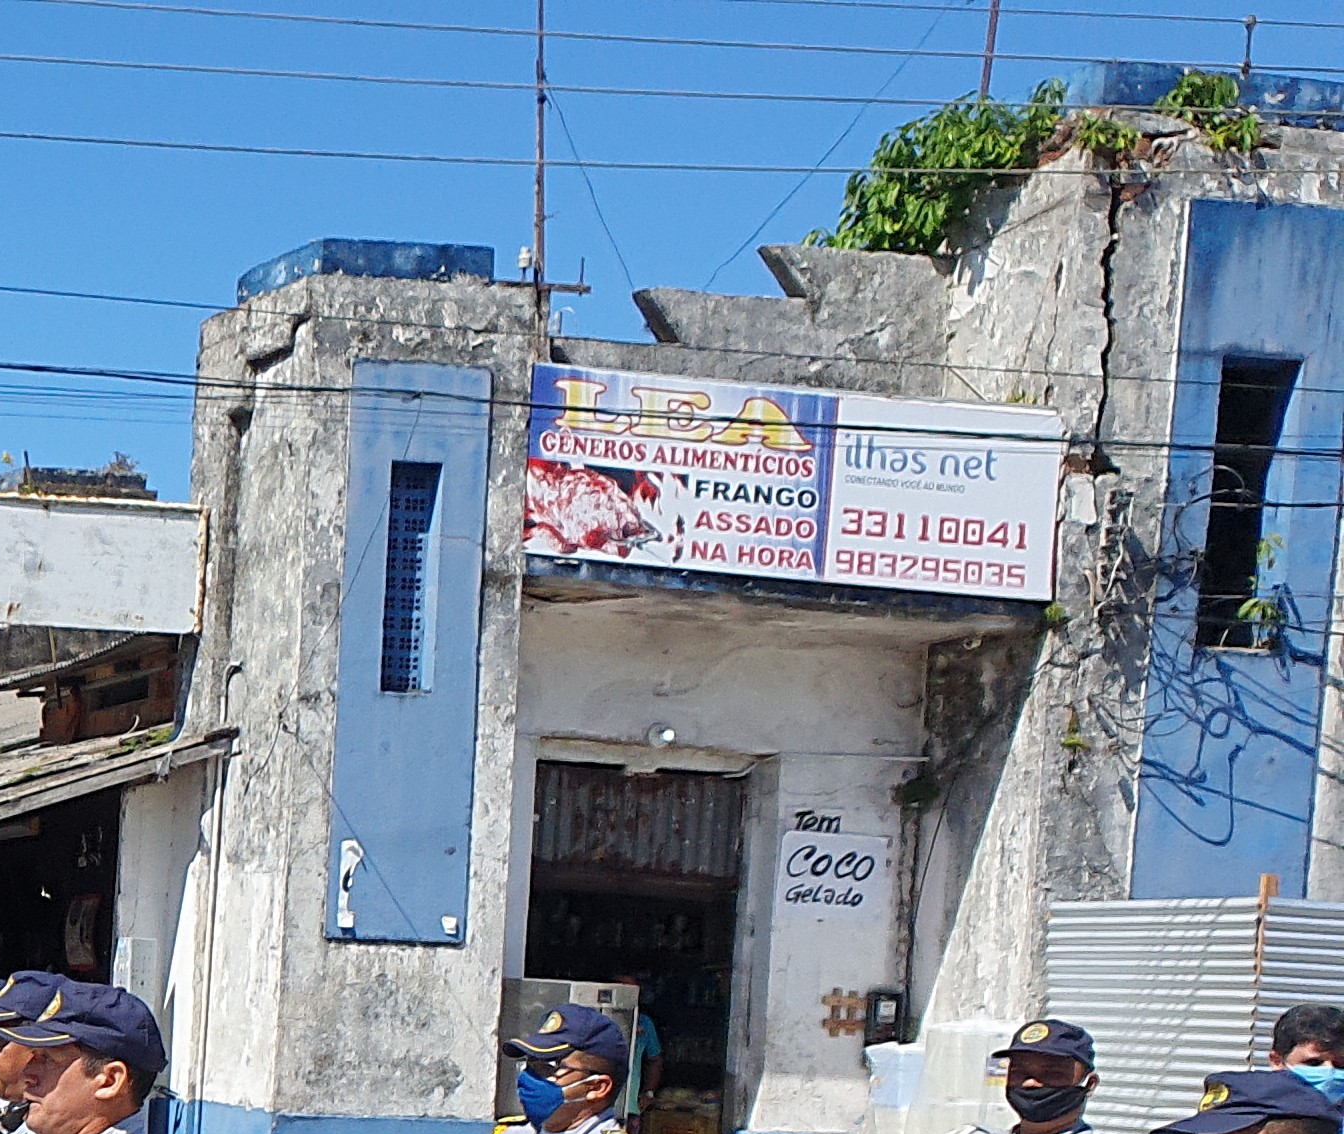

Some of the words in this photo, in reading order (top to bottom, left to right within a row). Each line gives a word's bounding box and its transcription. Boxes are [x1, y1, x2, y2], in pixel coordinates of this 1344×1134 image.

[553, 378, 814, 453] LEA
[541, 428, 648, 462] GÊNEROS
[652, 443, 815, 478] ALIMENTÍCIOS
[845, 432, 928, 475] ilhas
[940, 449, 999, 481] net
[694, 479, 818, 508] FRANGO
[693, 510, 816, 540] ASSADO
[840, 507, 1028, 550] 33110041
[690, 540, 728, 563] NA
[737, 546, 814, 570] HORA
[794, 809, 842, 834] Tem
